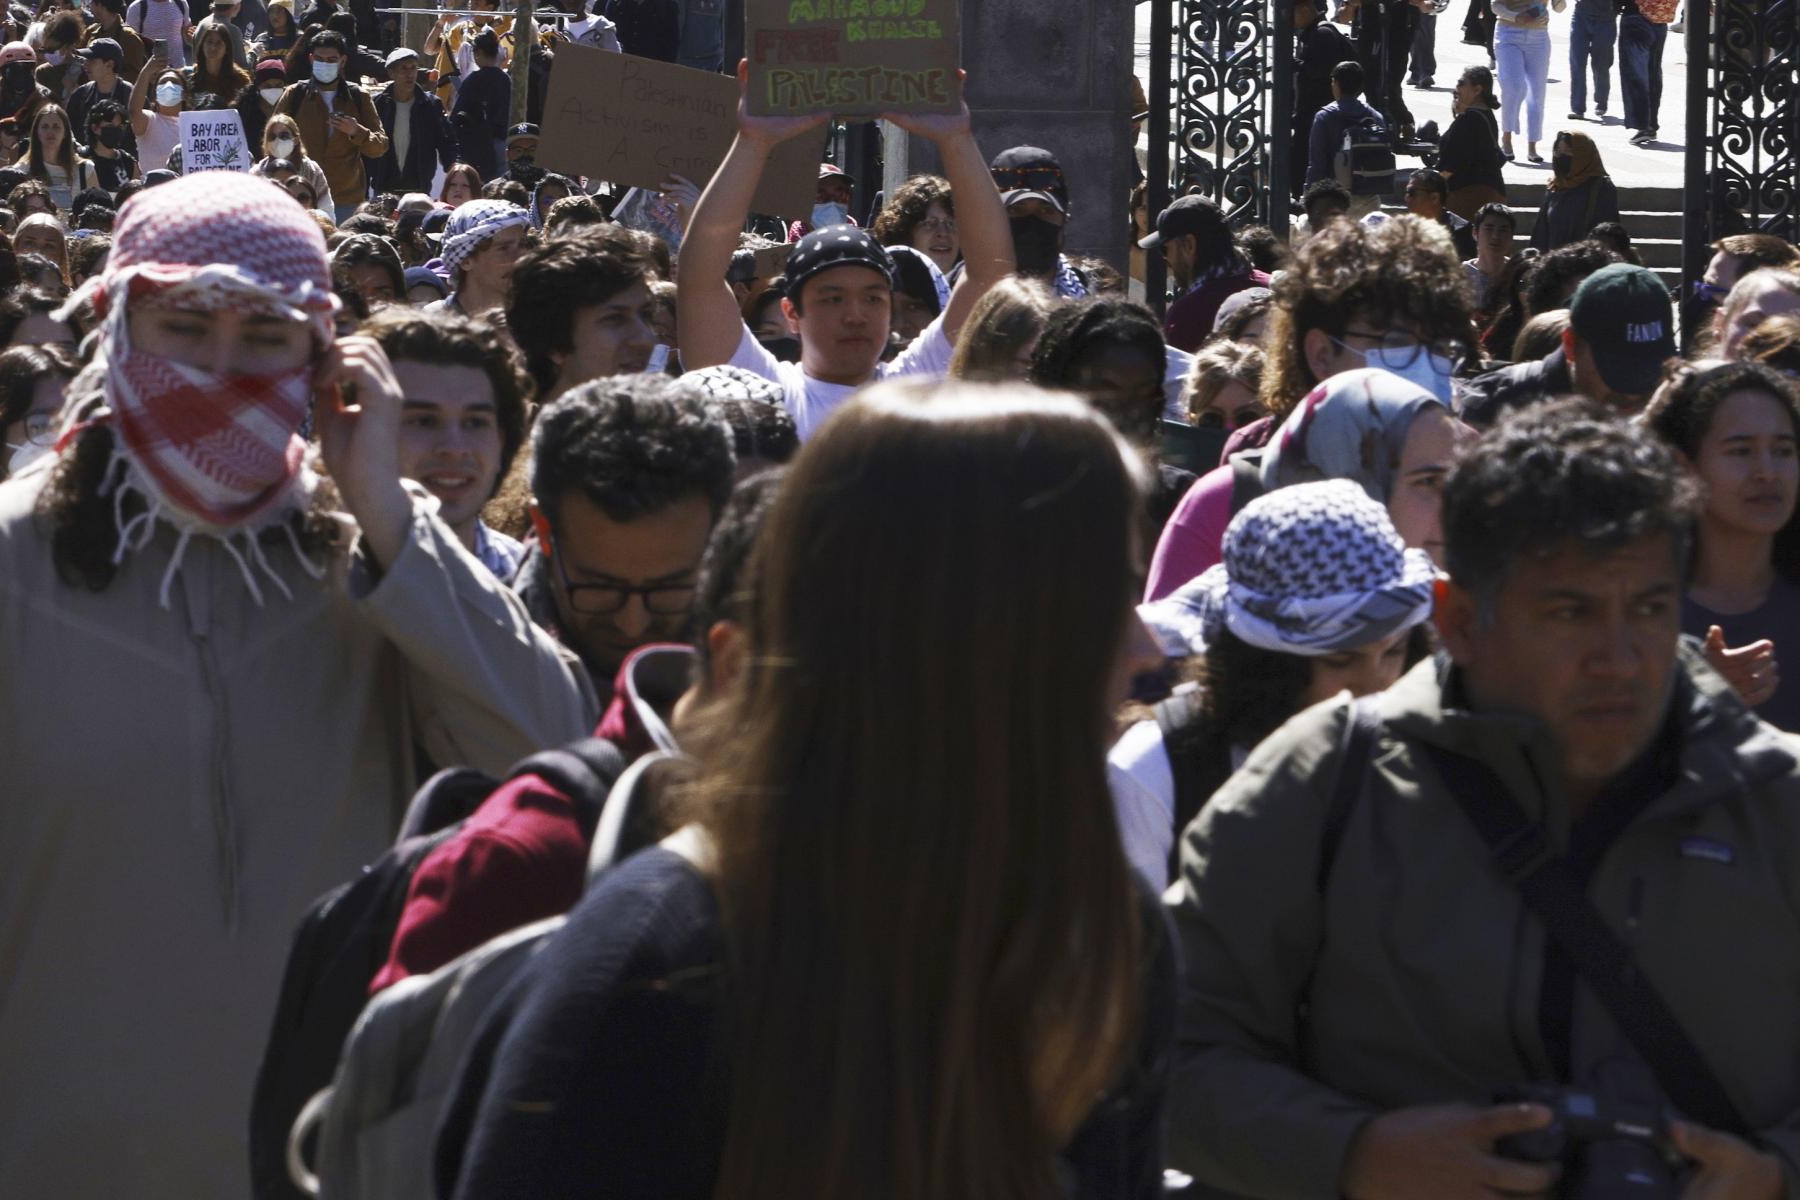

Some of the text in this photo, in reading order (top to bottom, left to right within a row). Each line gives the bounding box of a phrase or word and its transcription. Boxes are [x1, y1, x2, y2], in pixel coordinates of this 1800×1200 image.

[845, 20, 942, 41] KHALIL
[755, 26, 841, 65] FREE
[767, 65, 951, 110] PALESTINE
[191, 123, 239, 137] BAY AREA
[560, 97, 709, 141] Activism is
[188, 138, 220, 152] LABOR
[607, 137, 716, 170] A Crim
[195, 154, 211, 165] FOR
